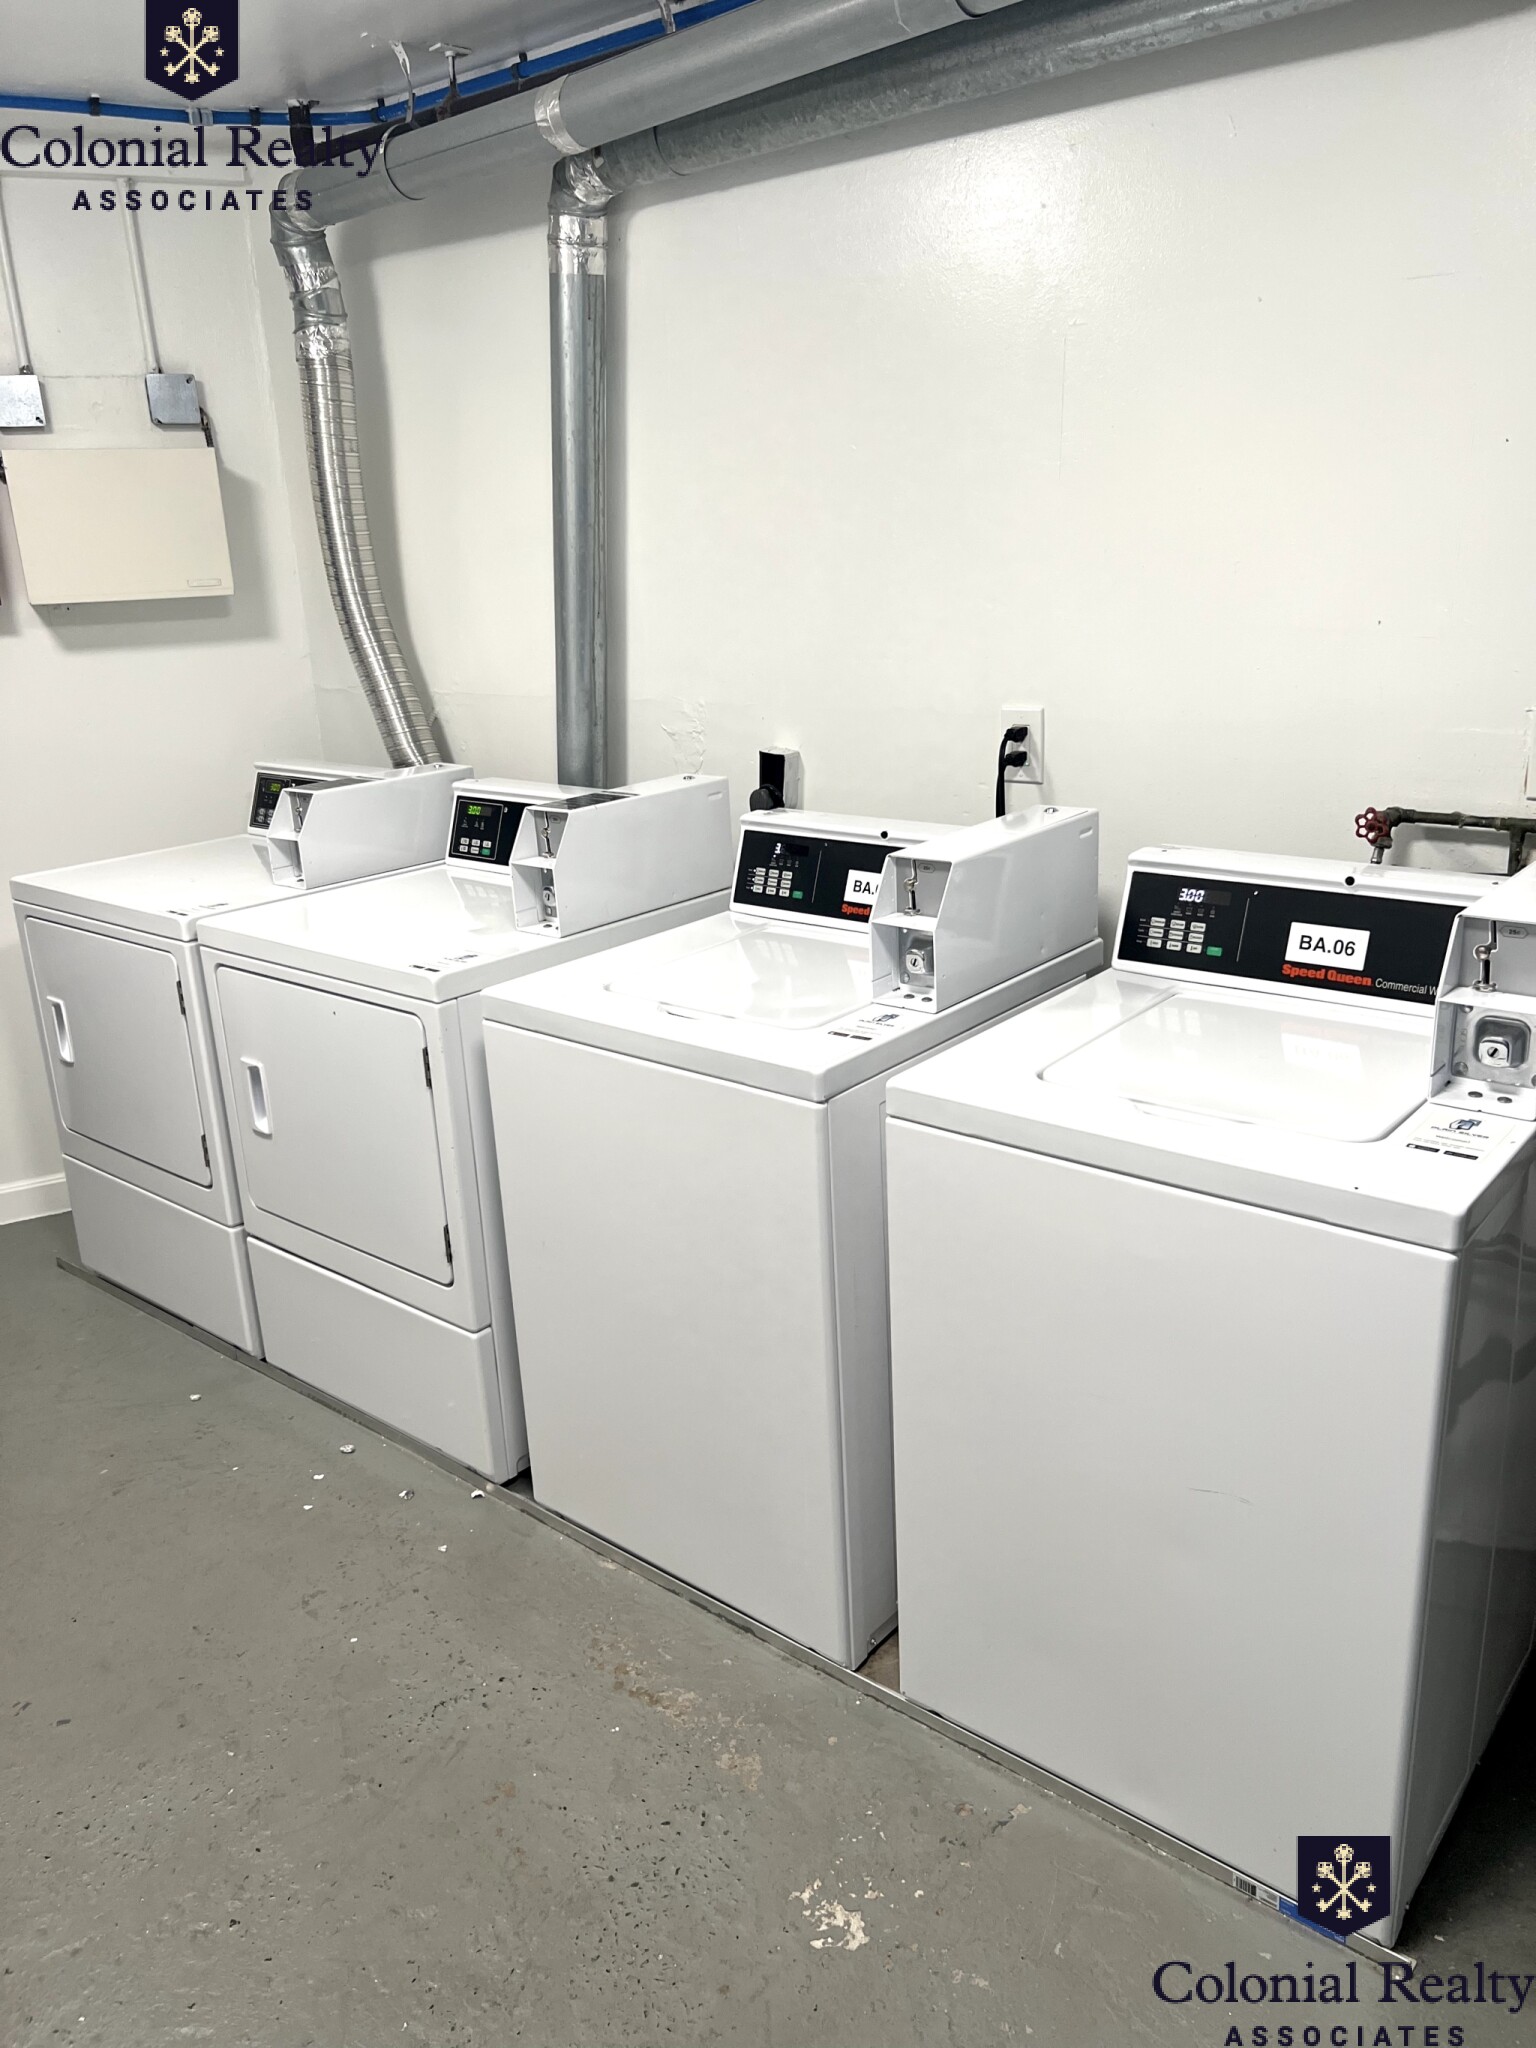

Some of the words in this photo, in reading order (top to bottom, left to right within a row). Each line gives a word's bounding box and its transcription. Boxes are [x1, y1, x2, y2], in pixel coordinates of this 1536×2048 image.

[853, 880, 879, 895] BA.
[841, 903, 871, 916] Speed
[1299, 935, 1356, 957] BA.06
[1282, 963, 1325, 979] Speed
[1326, 969, 1372, 987] Queen
[1375, 978, 1428, 995] Commercial
